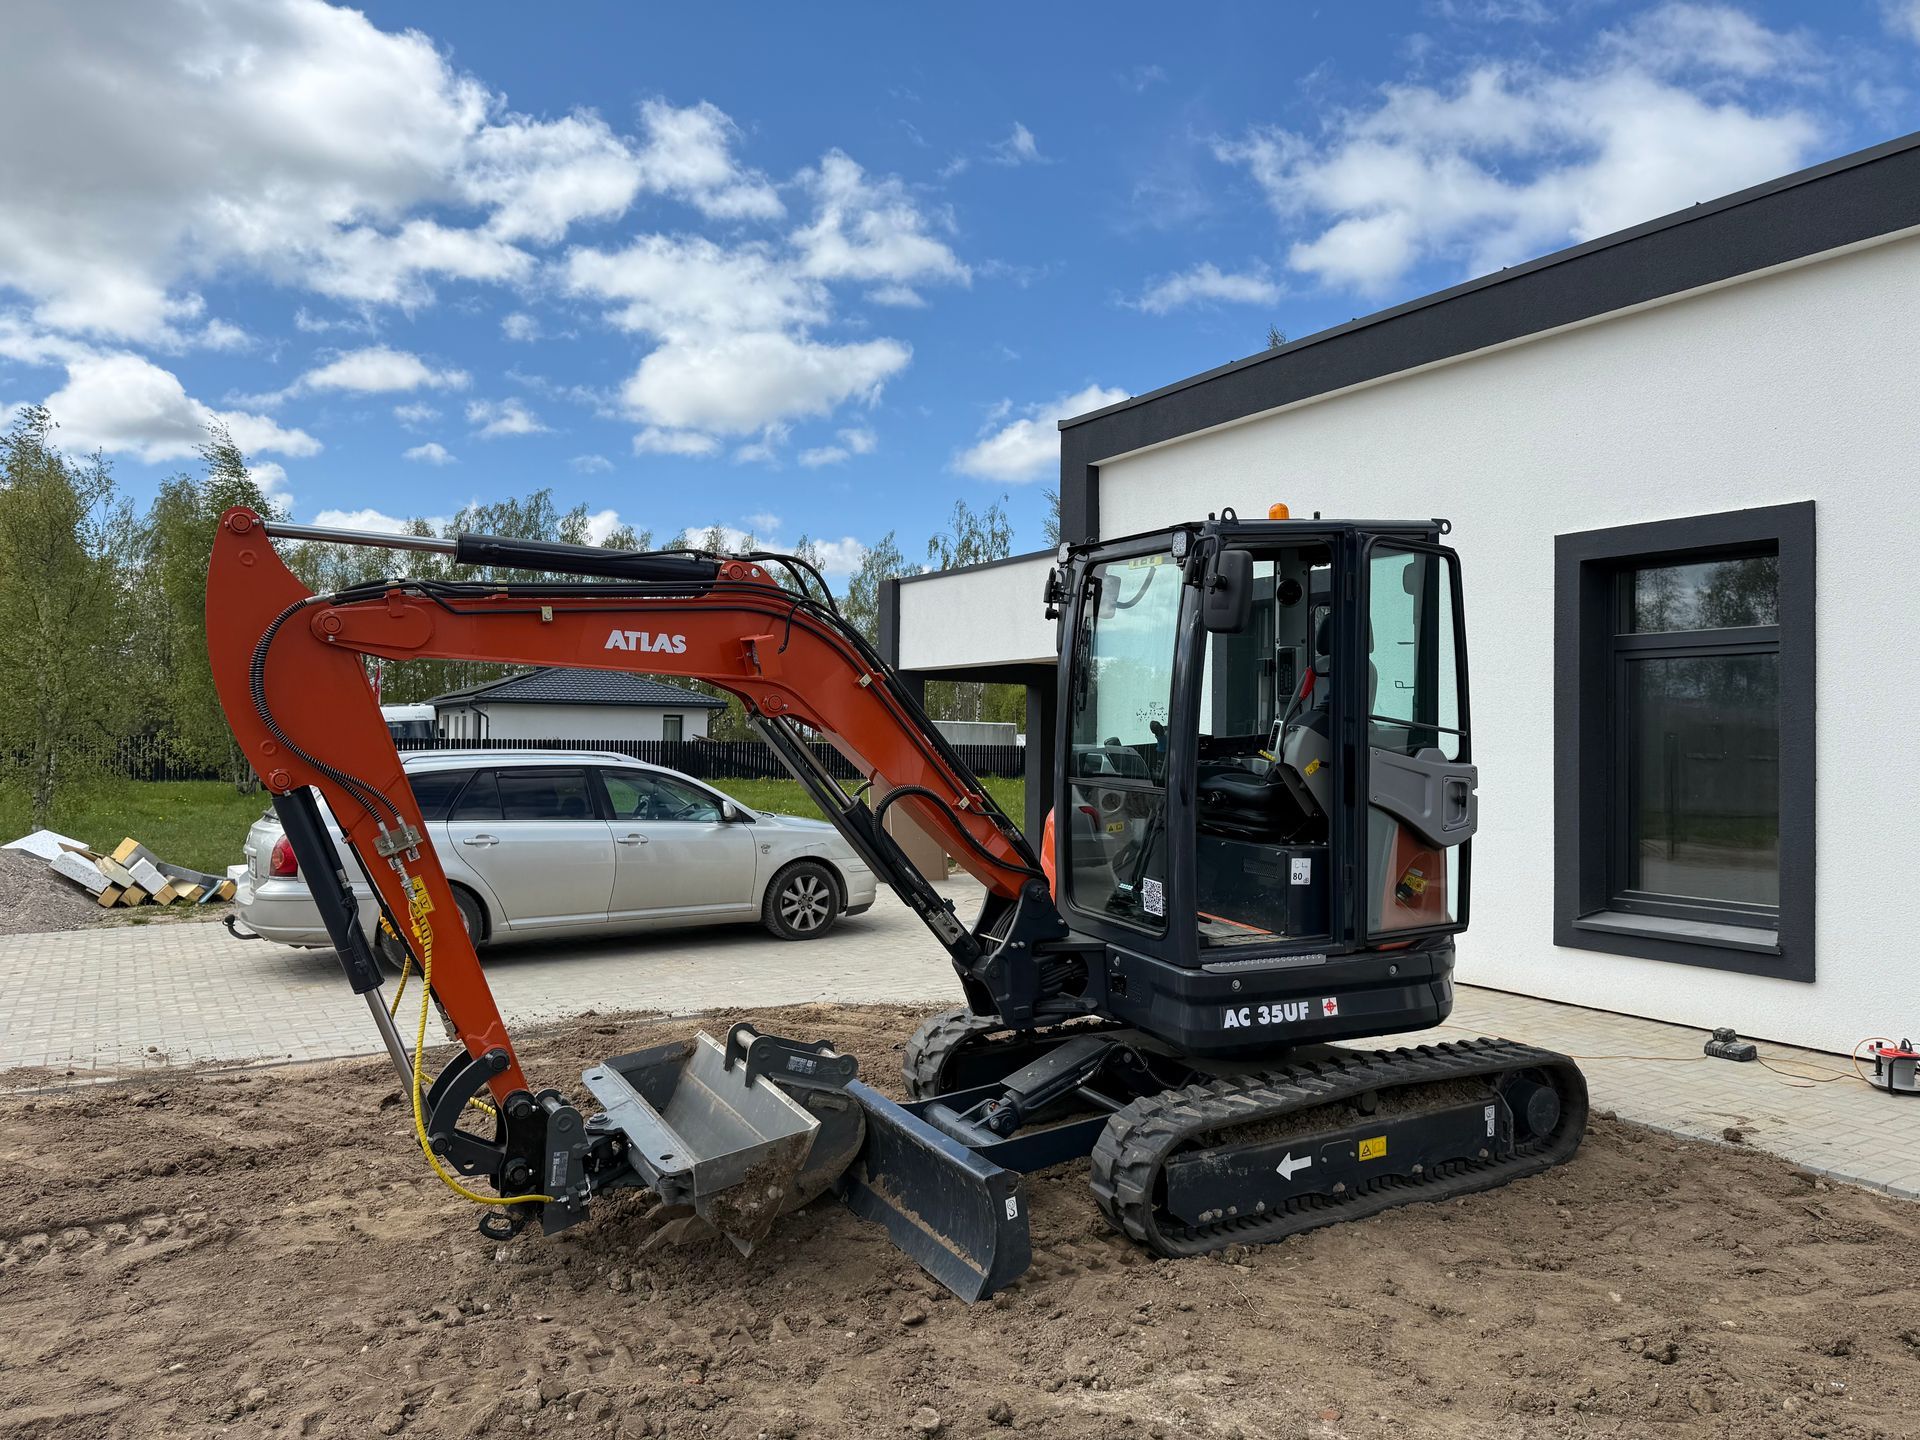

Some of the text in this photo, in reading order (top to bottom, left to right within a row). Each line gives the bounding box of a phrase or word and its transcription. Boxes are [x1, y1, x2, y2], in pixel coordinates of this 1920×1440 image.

[604, 630, 687, 654] ATLAS
[1292, 872, 1303, 881] 80
[1223, 1001, 1309, 1029] AC 35UF
